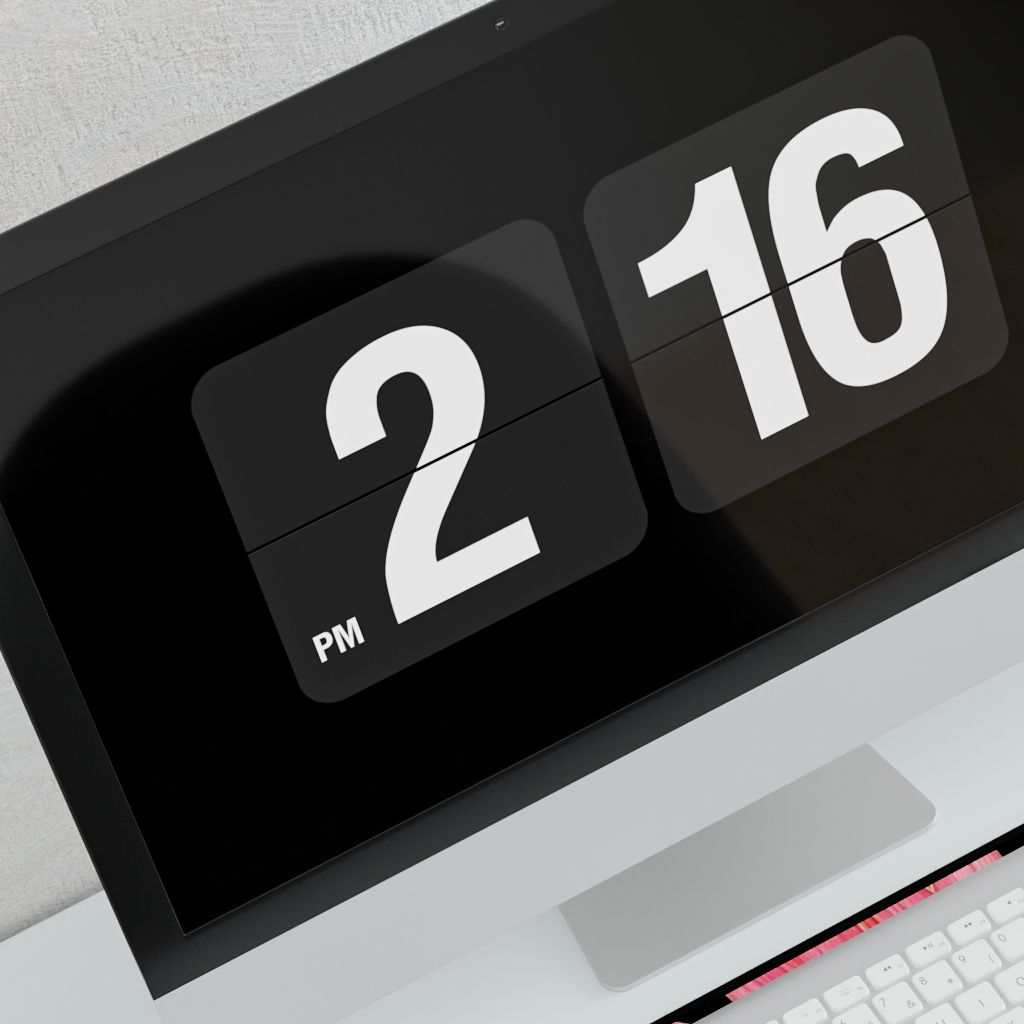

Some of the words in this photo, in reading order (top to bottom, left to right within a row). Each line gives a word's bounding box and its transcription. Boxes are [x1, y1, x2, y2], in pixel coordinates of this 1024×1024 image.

[326, 326, 540, 624] 2
[638, 108, 947, 439] 16
[312, 617, 364, 663] PM
[879, 997, 885, 1007] 7
[919, 977, 927, 985] 8
[958, 955, 966, 964] 9
[998, 933, 1006, 942] 0
